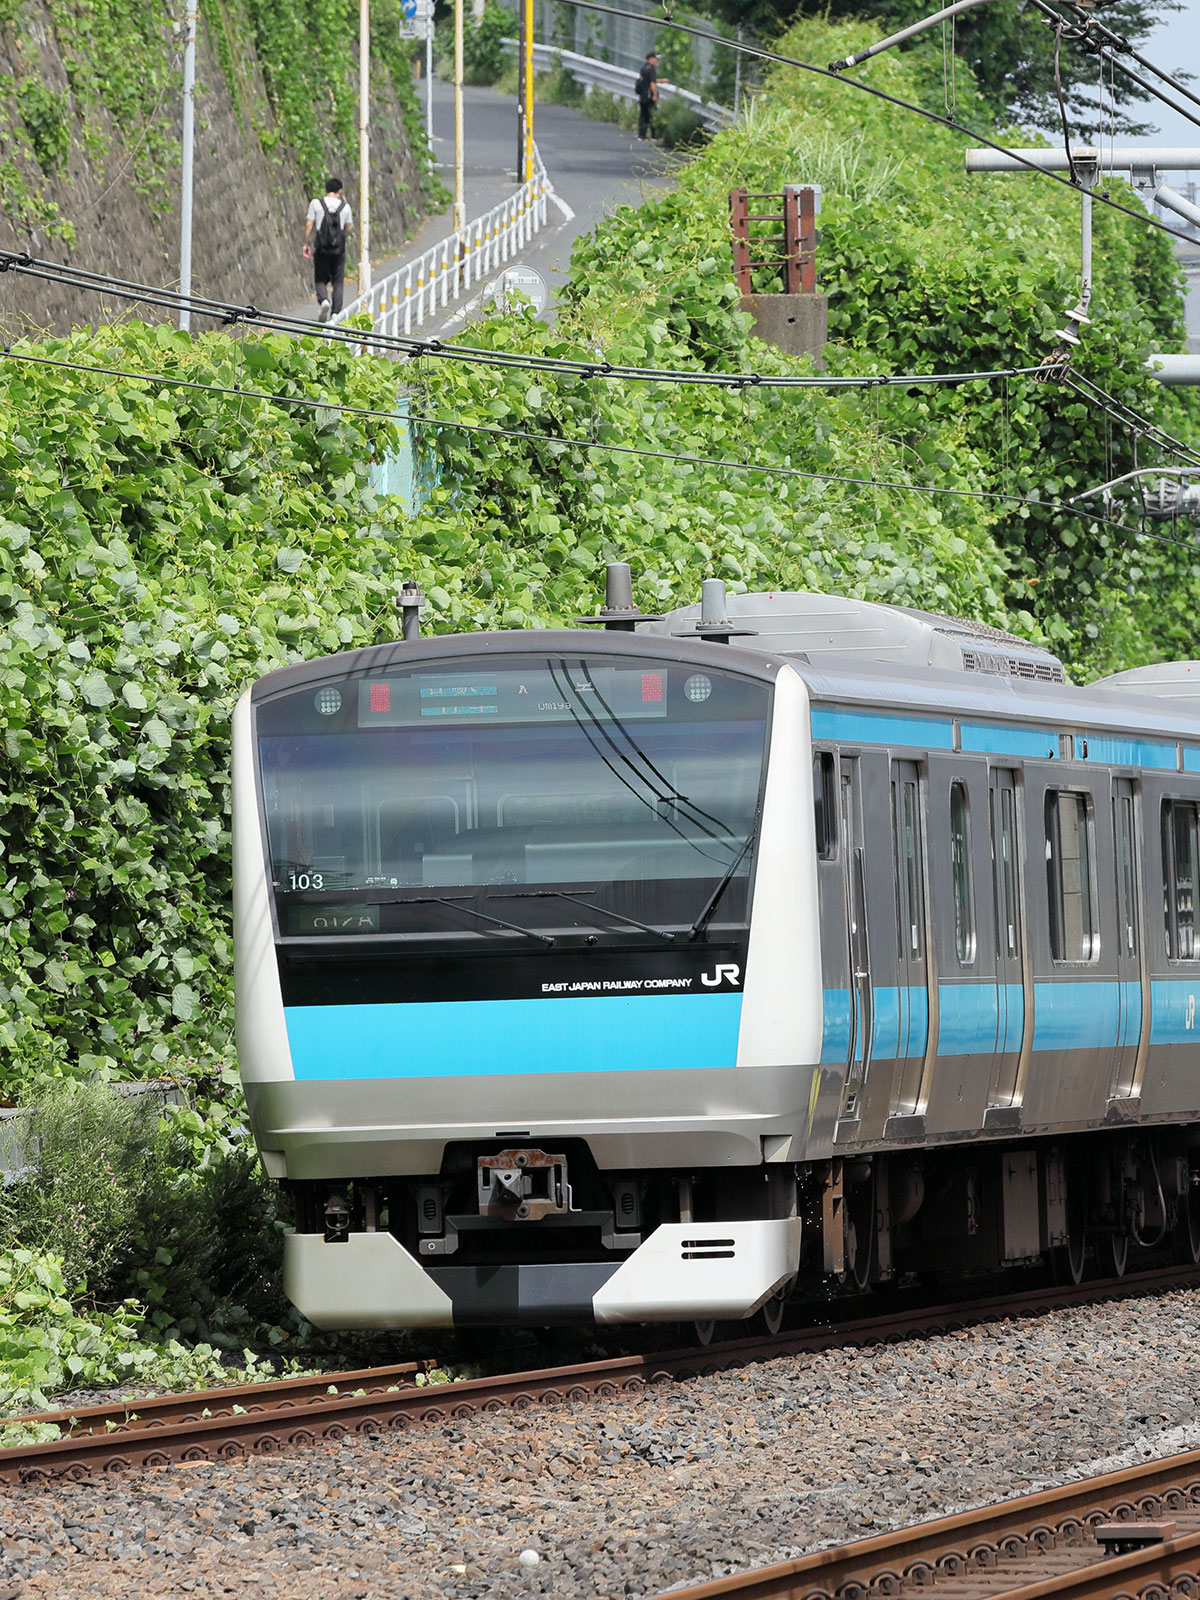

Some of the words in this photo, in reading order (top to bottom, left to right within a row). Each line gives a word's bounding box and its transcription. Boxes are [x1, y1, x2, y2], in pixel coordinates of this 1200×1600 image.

[289, 874, 324, 890] 103
[541, 982, 568, 992] EAST
[568, 981, 601, 991] JAPAN
[603, 979, 643, 990] RAILWAY
[644, 978, 692, 989] COMPANY
[700, 963, 741, 987] JR
[1185, 994, 1196, 1030] JR
